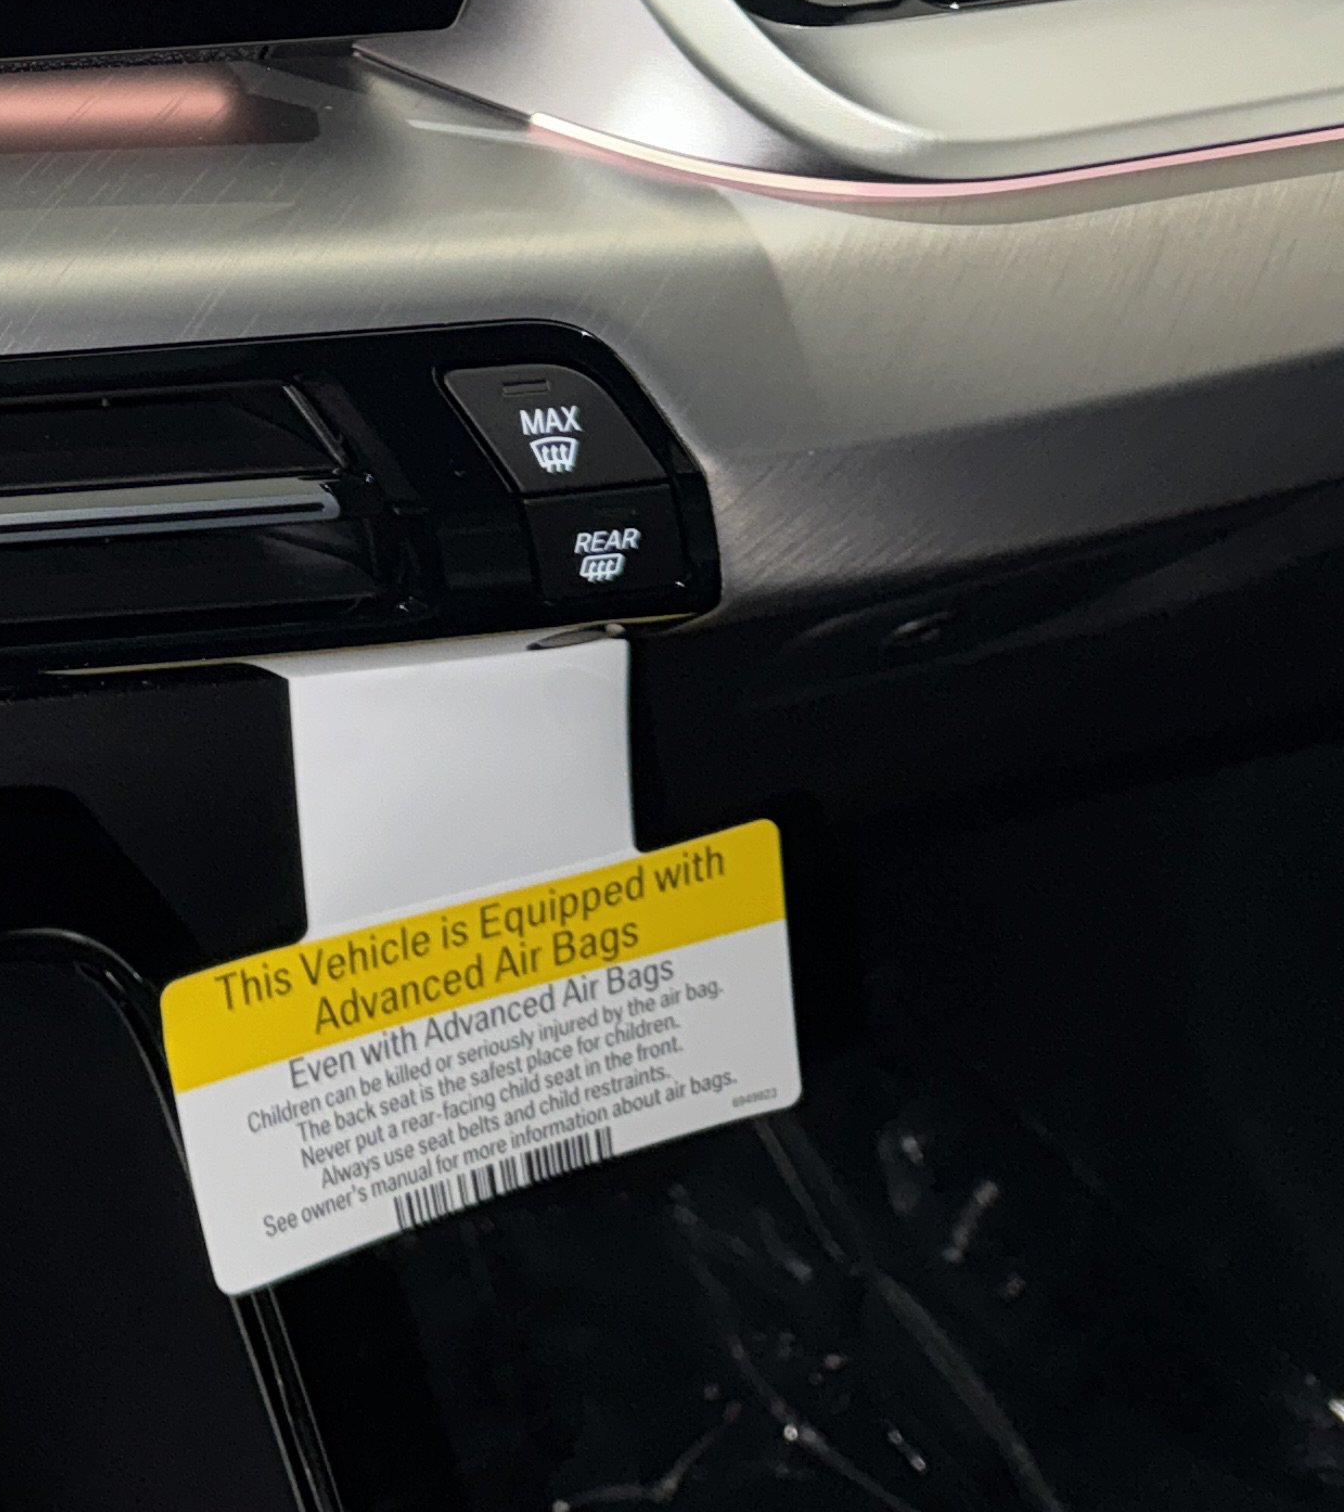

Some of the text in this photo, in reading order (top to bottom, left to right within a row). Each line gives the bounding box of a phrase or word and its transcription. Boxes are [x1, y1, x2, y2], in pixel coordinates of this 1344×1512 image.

[519, 405, 583, 436] MAX
[574, 528, 641, 554] REAR
[214, 845, 725, 1011] This Vehicle is Equipped with
[315, 921, 639, 1035] Advanced Air Bags
[247, 978, 724, 1134] Children can be killed or seriously injured by the air bag.
[288, 958, 675, 1090] Even with Advanced Air Bags
[296, 1014, 681, 1143] The back seat is the safest place for children.
[262, 1069, 739, 1239] See owner's manual for more information about air bags.
[299, 1034, 684, 1169] Never put a rear-facing child seat in the front.
[320, 1063, 672, 1189] Always use seat belts and child restraints.
